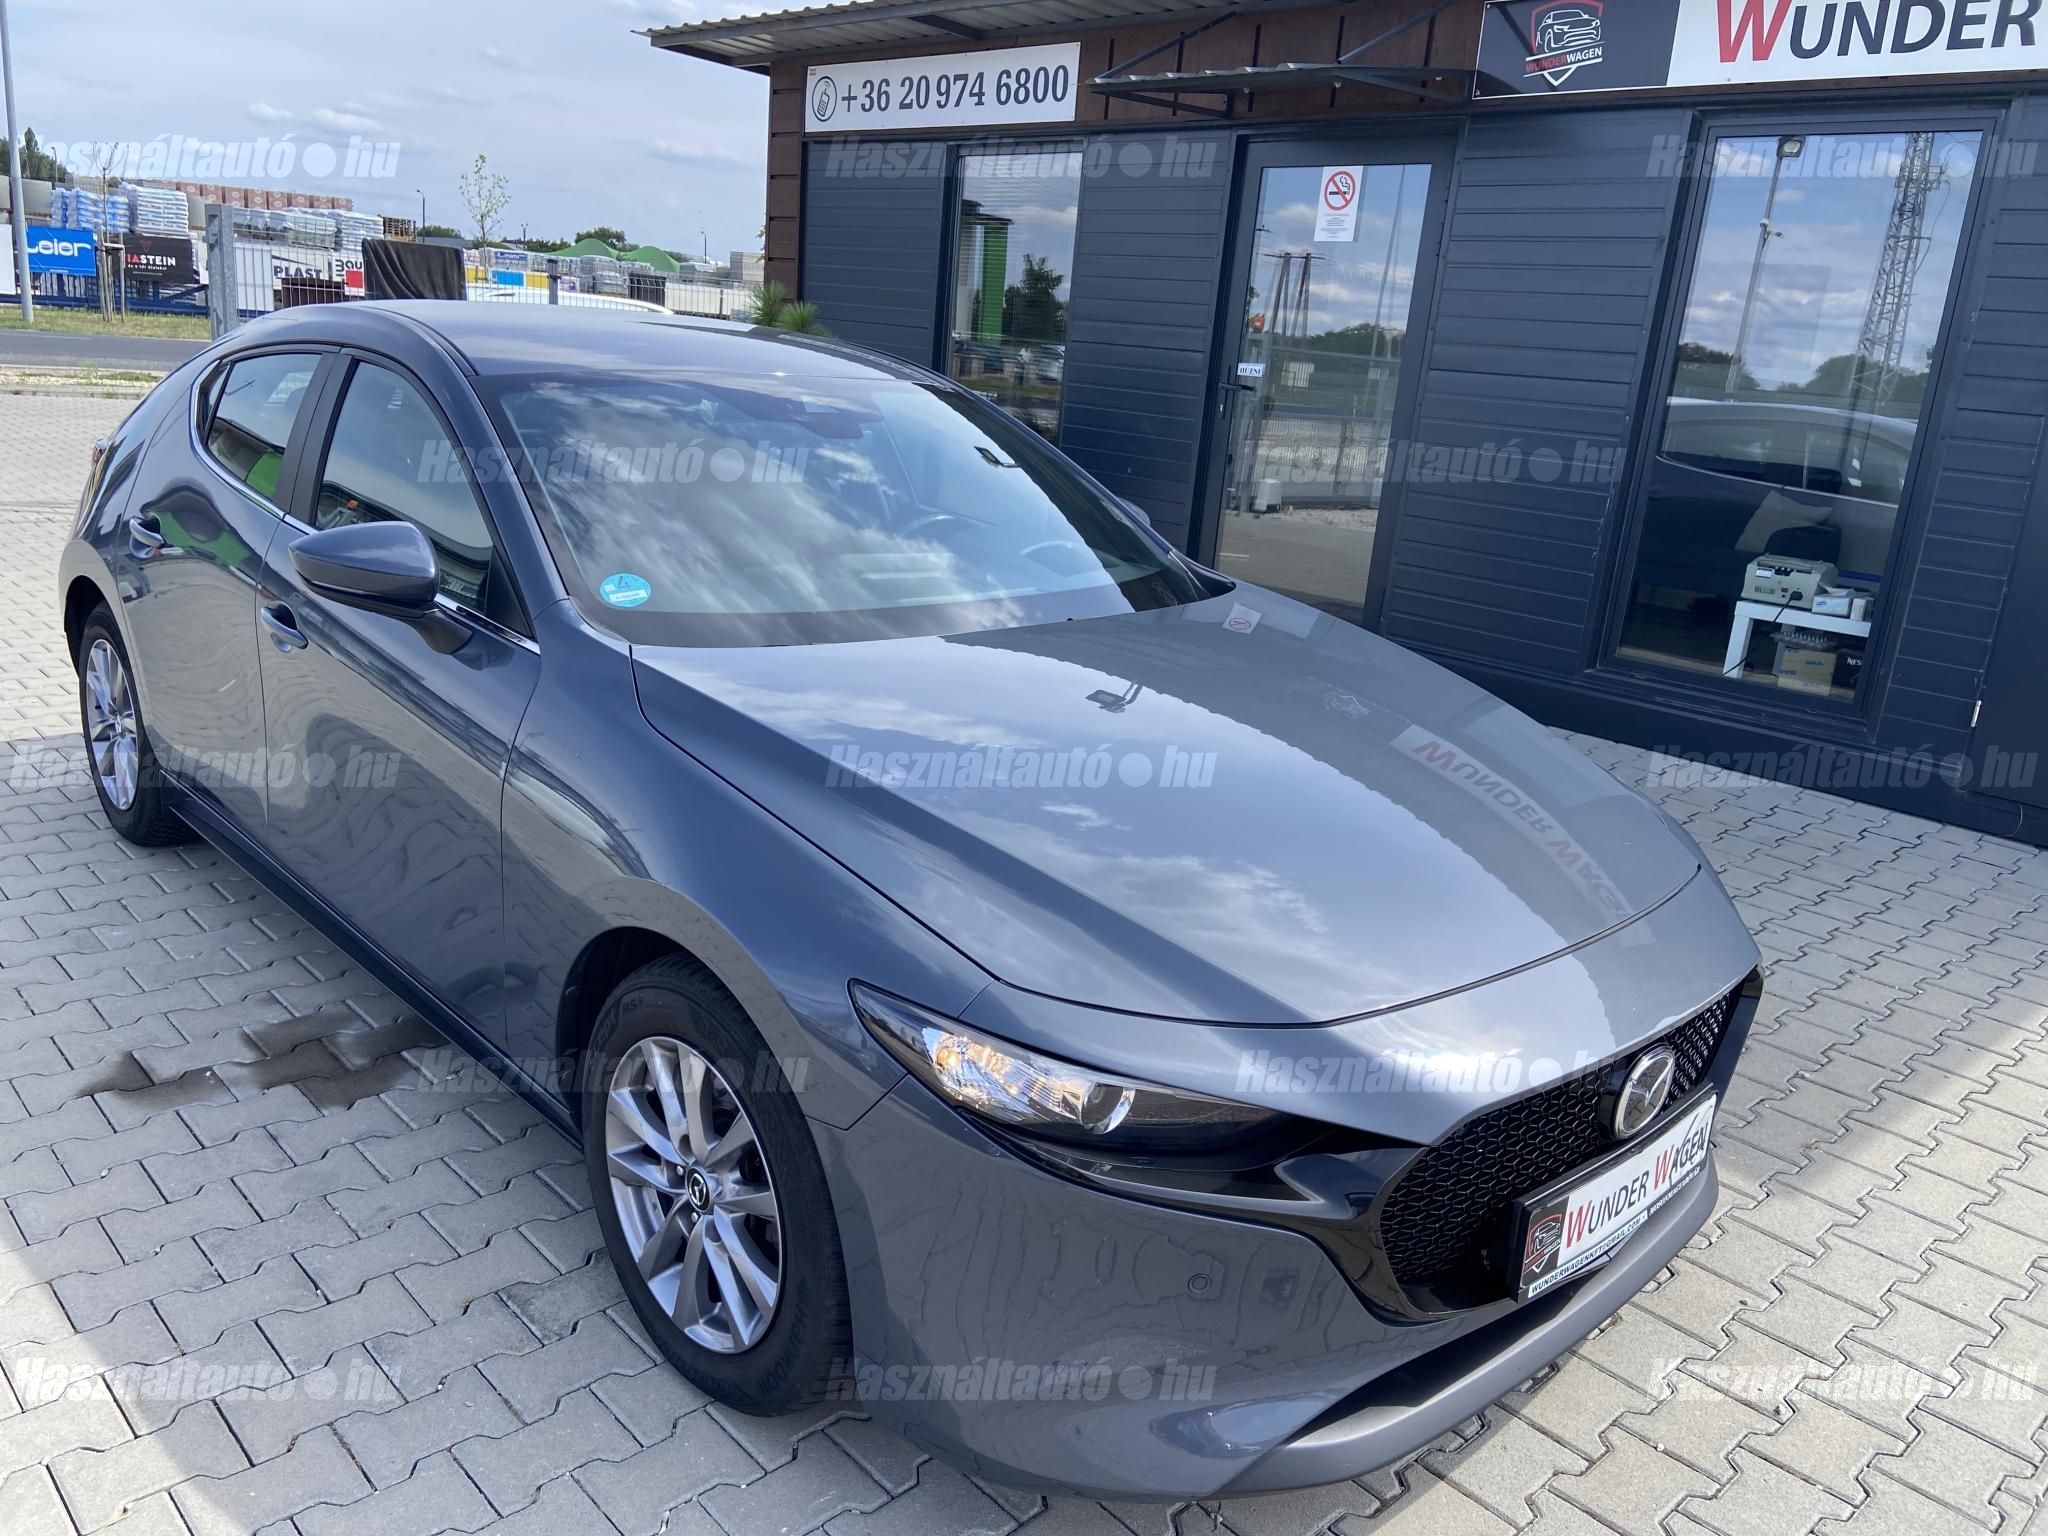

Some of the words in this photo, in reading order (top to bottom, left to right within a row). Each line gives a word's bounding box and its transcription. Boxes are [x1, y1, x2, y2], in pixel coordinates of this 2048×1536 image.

[1717, 0, 2038, 63] WUNDER
[1525, 46, 1603, 73] WUNDERWAGEN
[841, 78, 890, 113] +36
[899, 75, 929, 110] 20
[936, 71, 986, 109] 974
[996, 64, 1069, 106] 6800
[125, 253, 176, 267] IASTEIN
[273, 265, 322, 279] PLAST
[1566, 1169, 1650, 1249] WUNDER
[1653, 1121, 1709, 1190] WAGEN
